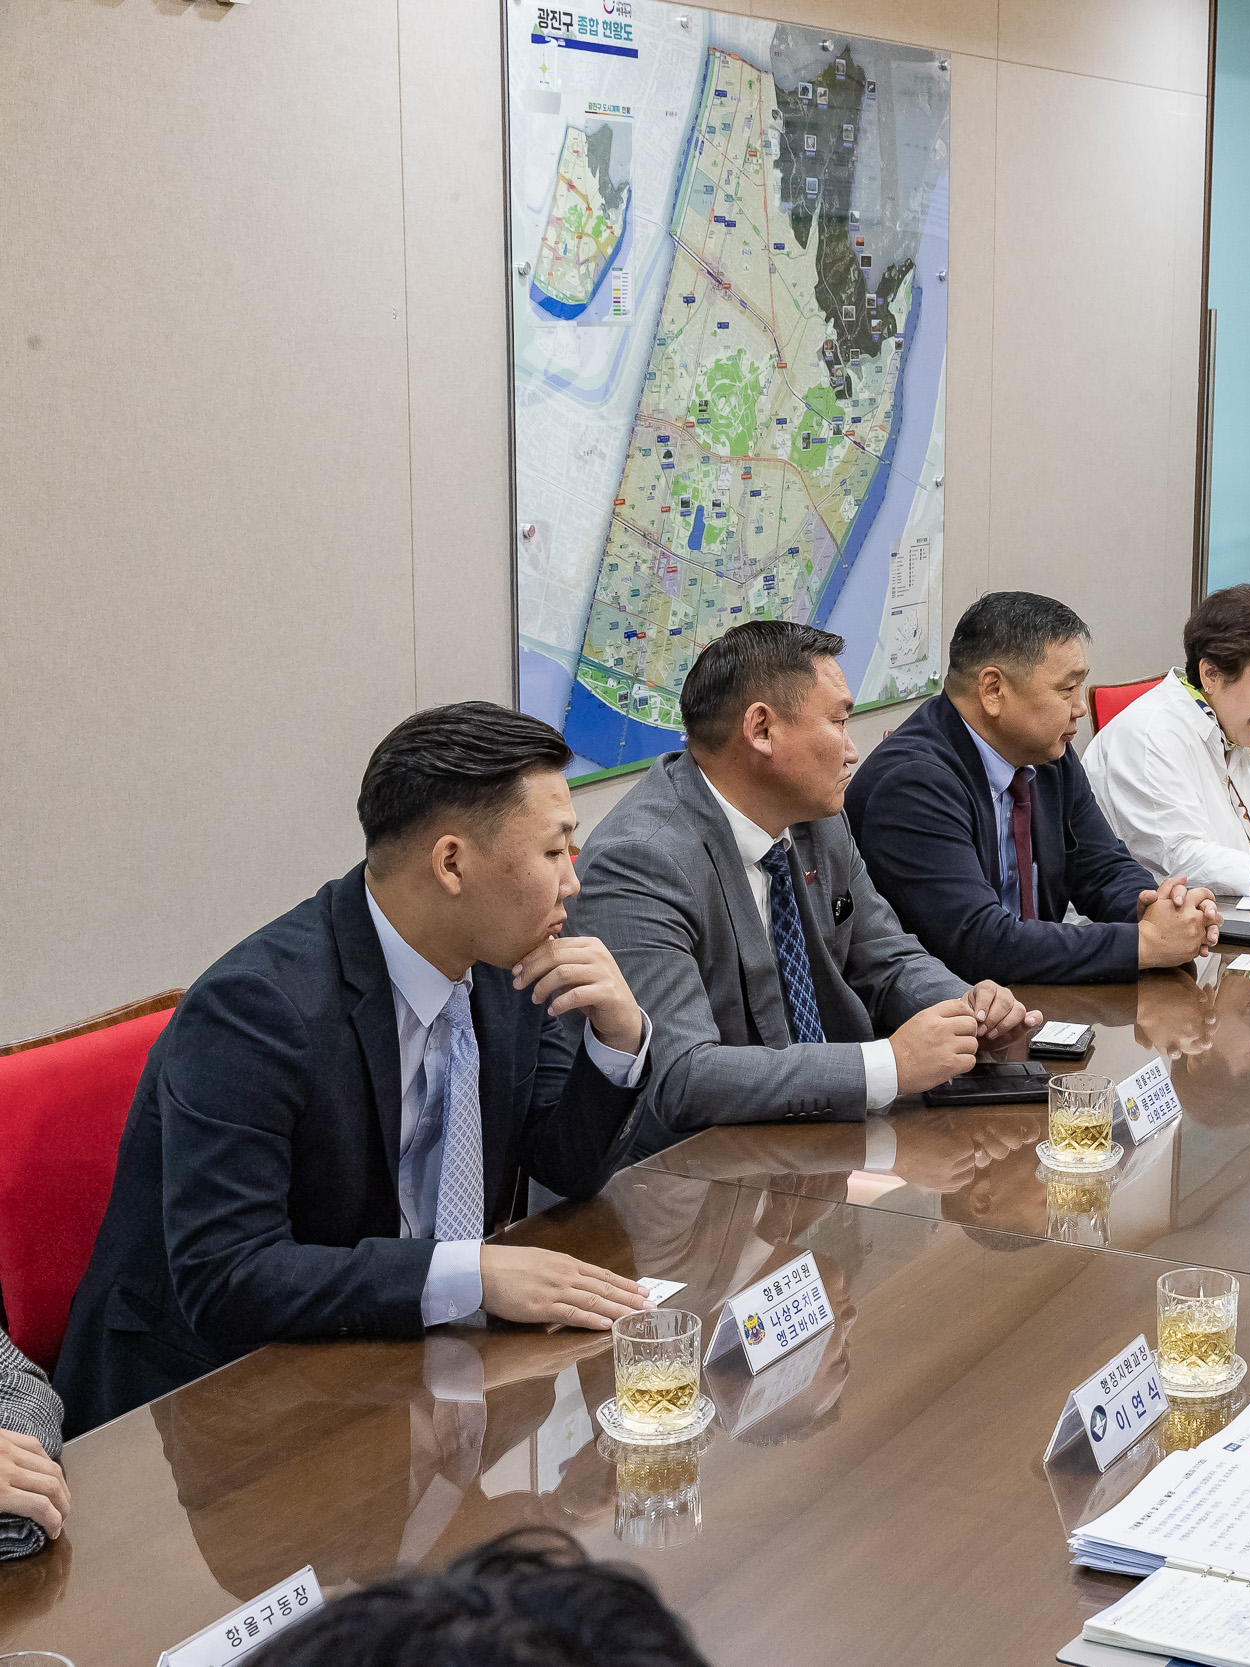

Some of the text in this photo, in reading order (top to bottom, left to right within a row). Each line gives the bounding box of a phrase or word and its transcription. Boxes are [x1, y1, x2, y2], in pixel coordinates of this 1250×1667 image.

[537, 7, 634, 42] 광진구 종합 현황도
[588, 102, 602, 112] 광진구
[1135, 1065, 1162, 1090] 항올구의원
[762, 1261, 812, 1302] 항올구의원
[769, 1286, 822, 1329] 나상오치르
[1100, 1344, 1148, 1395] 행정지원과장
[1115, 1376, 1162, 1431] 이연식
[225, 1584, 309, 1648] 항올구동장
